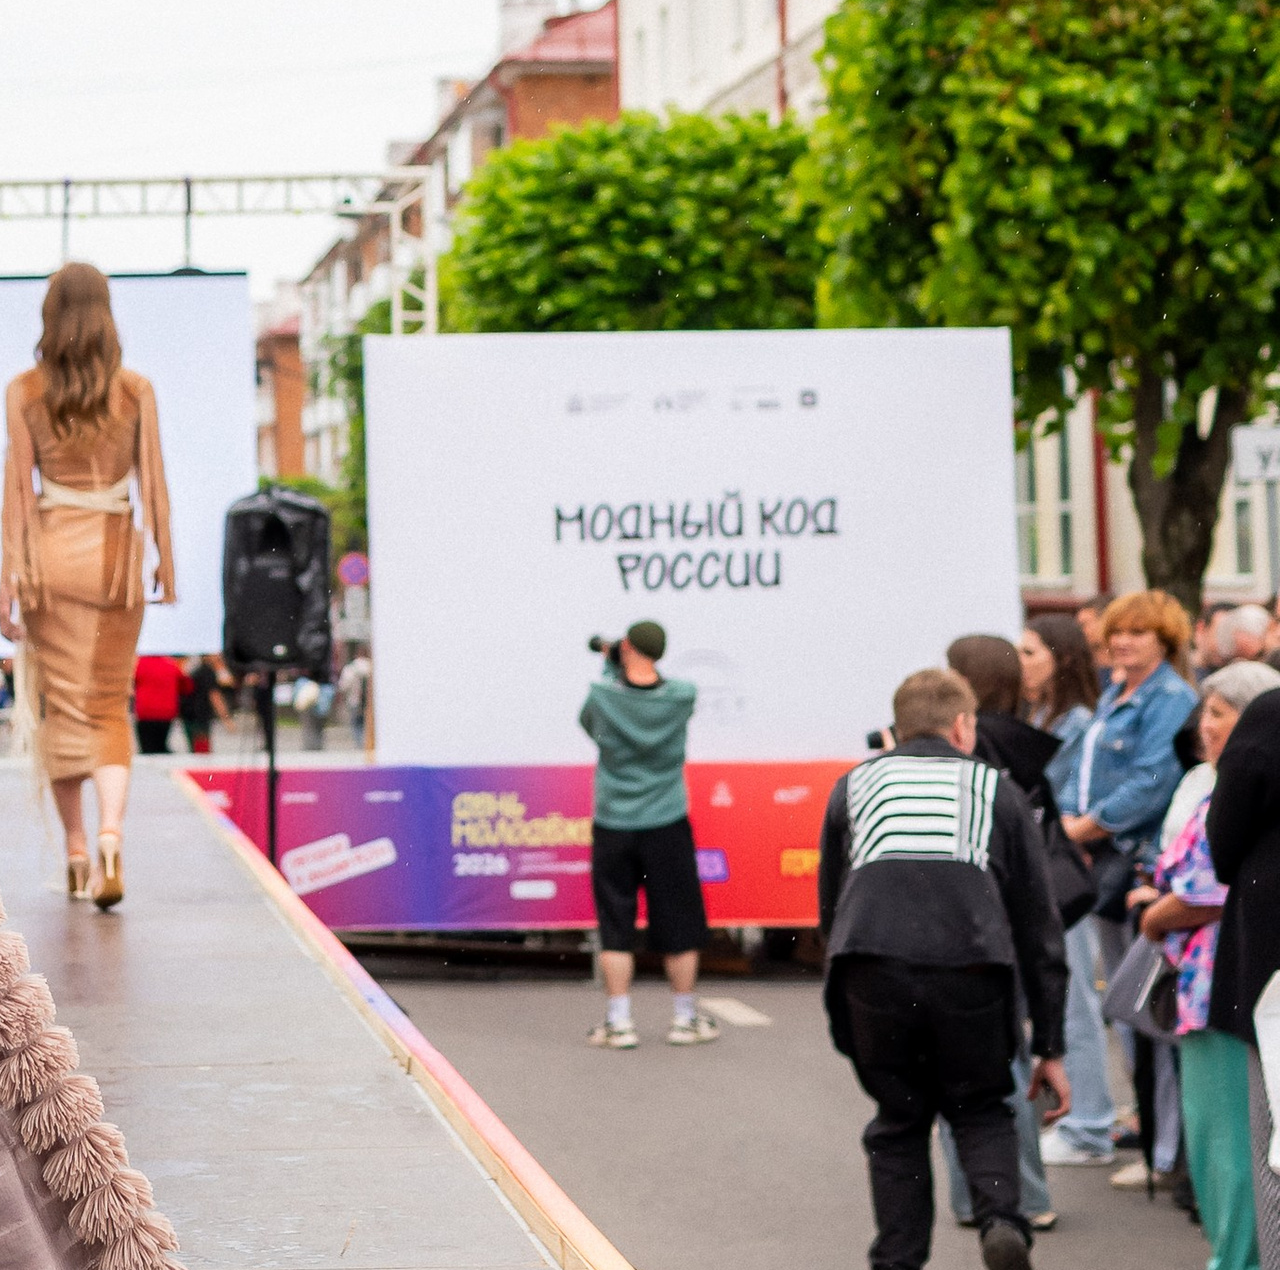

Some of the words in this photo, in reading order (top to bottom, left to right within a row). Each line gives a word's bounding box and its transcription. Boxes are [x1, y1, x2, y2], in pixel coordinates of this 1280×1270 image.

[554, 489, 742, 541] МОДНЫЙ
[757, 497, 837, 536] КОД
[617, 550, 781, 591] РОССИИ
